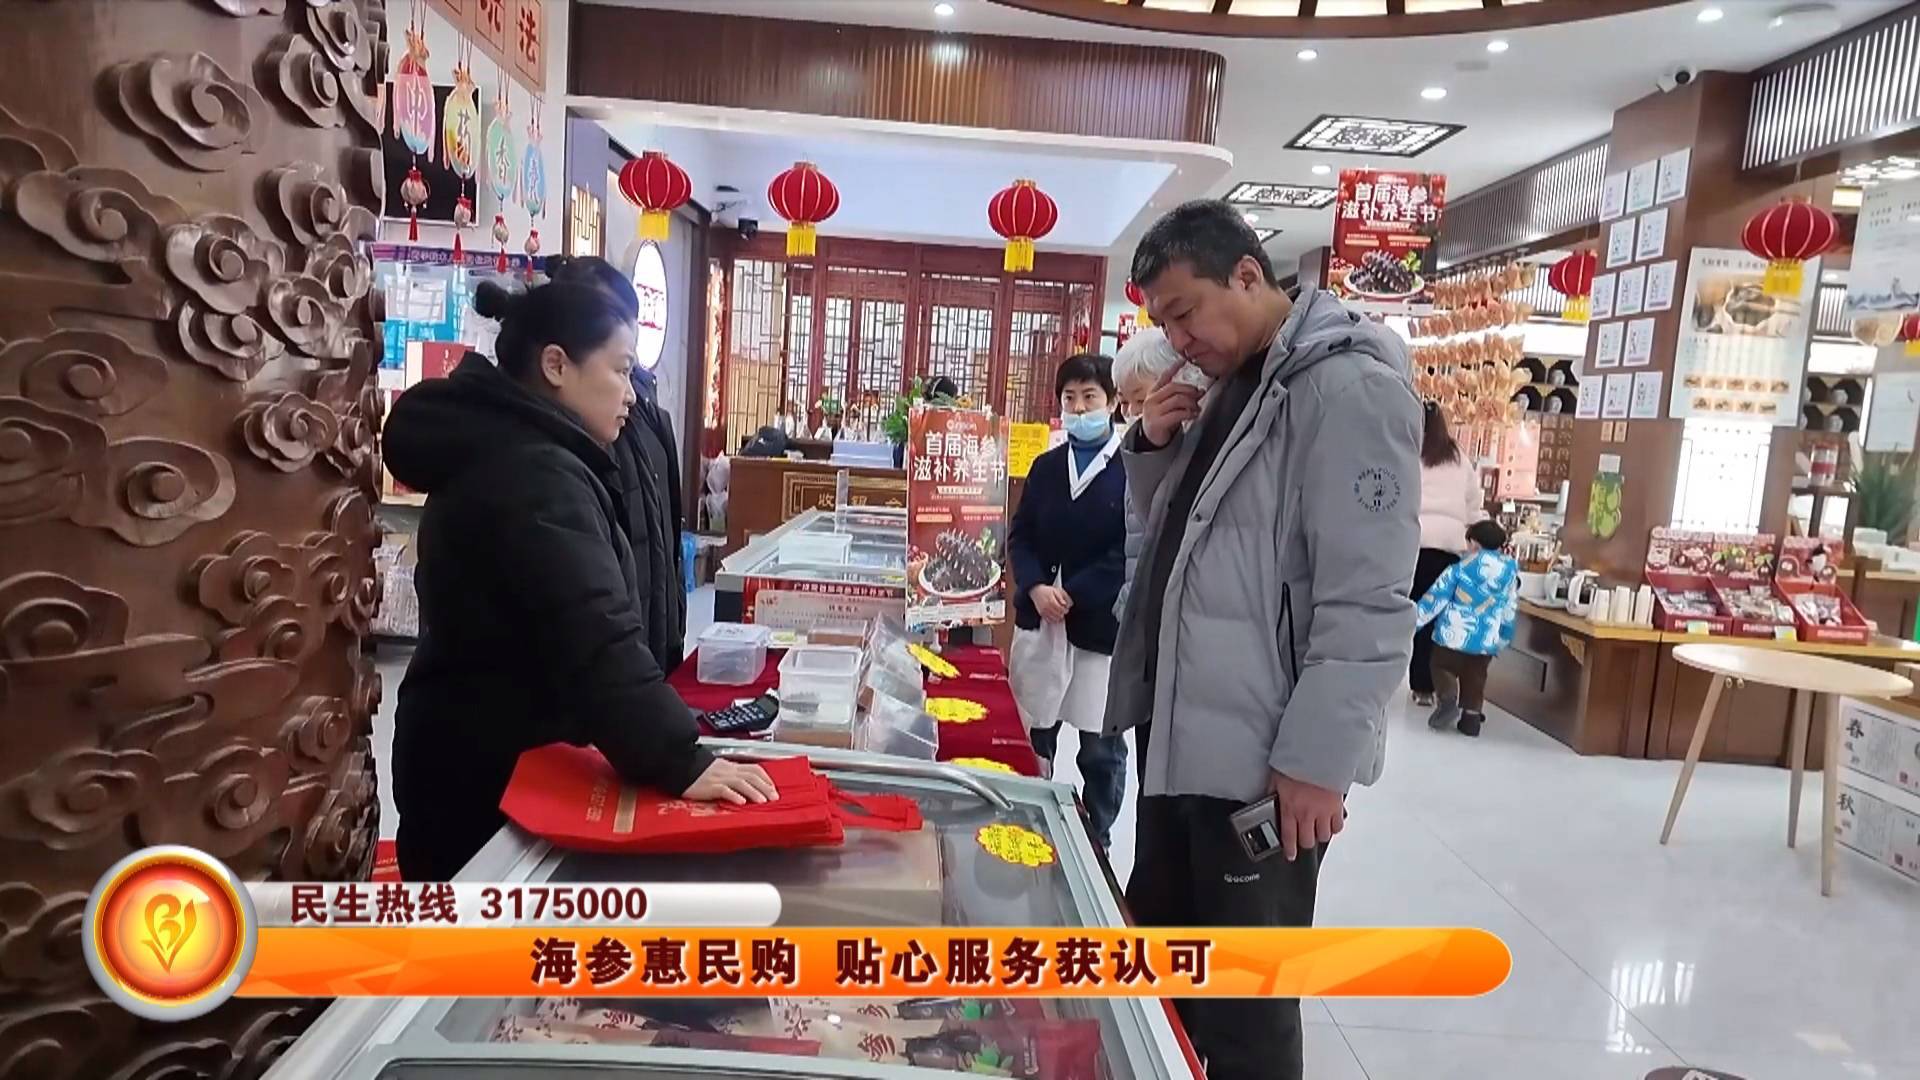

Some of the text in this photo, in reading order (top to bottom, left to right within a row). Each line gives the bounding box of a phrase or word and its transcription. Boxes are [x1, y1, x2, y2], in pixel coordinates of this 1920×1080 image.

[1355, 182, 1428, 205] 首届海参
[1341, 199, 1438, 222] 滋补养生节
[925, 431, 997, 458] 首届海参
[914, 456, 1005, 484] 滋补养生节
[1836, 794, 1855, 815] 秋
